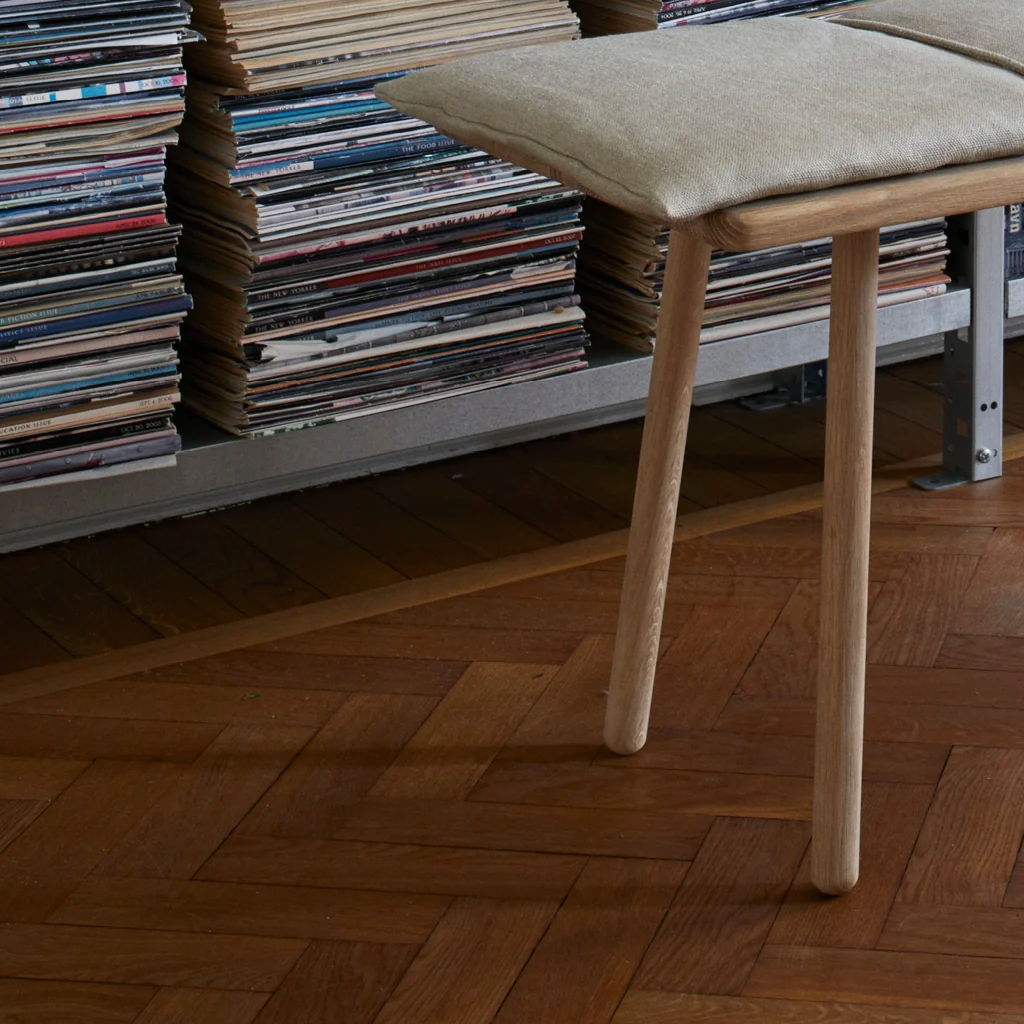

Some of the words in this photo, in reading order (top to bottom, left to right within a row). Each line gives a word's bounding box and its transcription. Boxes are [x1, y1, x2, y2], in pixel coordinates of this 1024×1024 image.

[401, 145, 414, 153] THE
[416, 141, 436, 150] FOOD
[257, 292, 270, 301] THE
[272, 288, 287, 298] NEW
[290, 282, 318, 294] YORKER
[8, 311, 38, 324] FICTION
[269, 320, 285, 330] NEW
